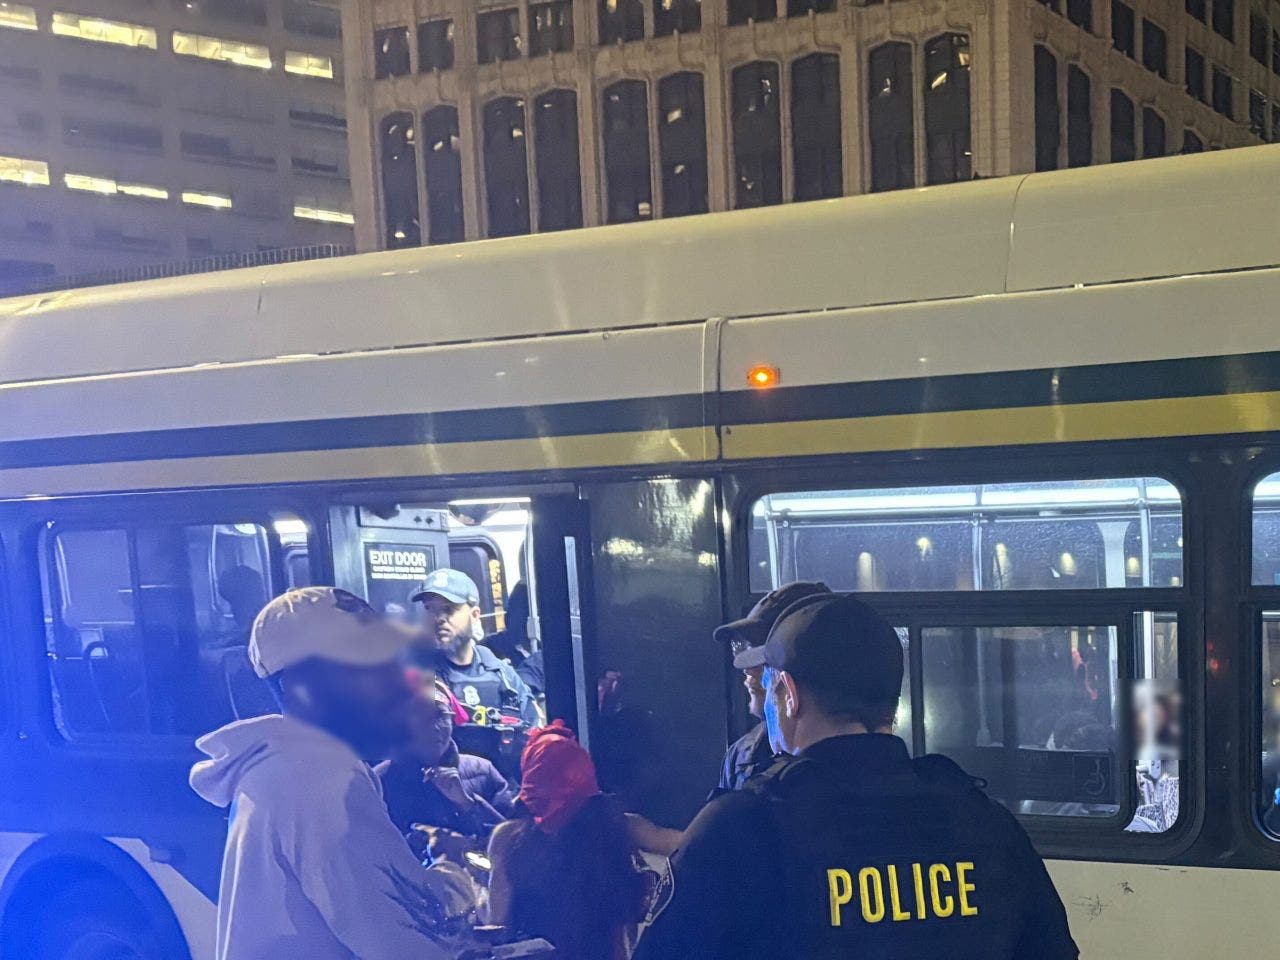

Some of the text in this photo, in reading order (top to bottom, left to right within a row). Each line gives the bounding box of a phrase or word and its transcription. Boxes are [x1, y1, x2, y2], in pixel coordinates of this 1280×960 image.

[369, 550, 426, 567] EXIT DOOR
[827, 861, 978, 927] POLICE
